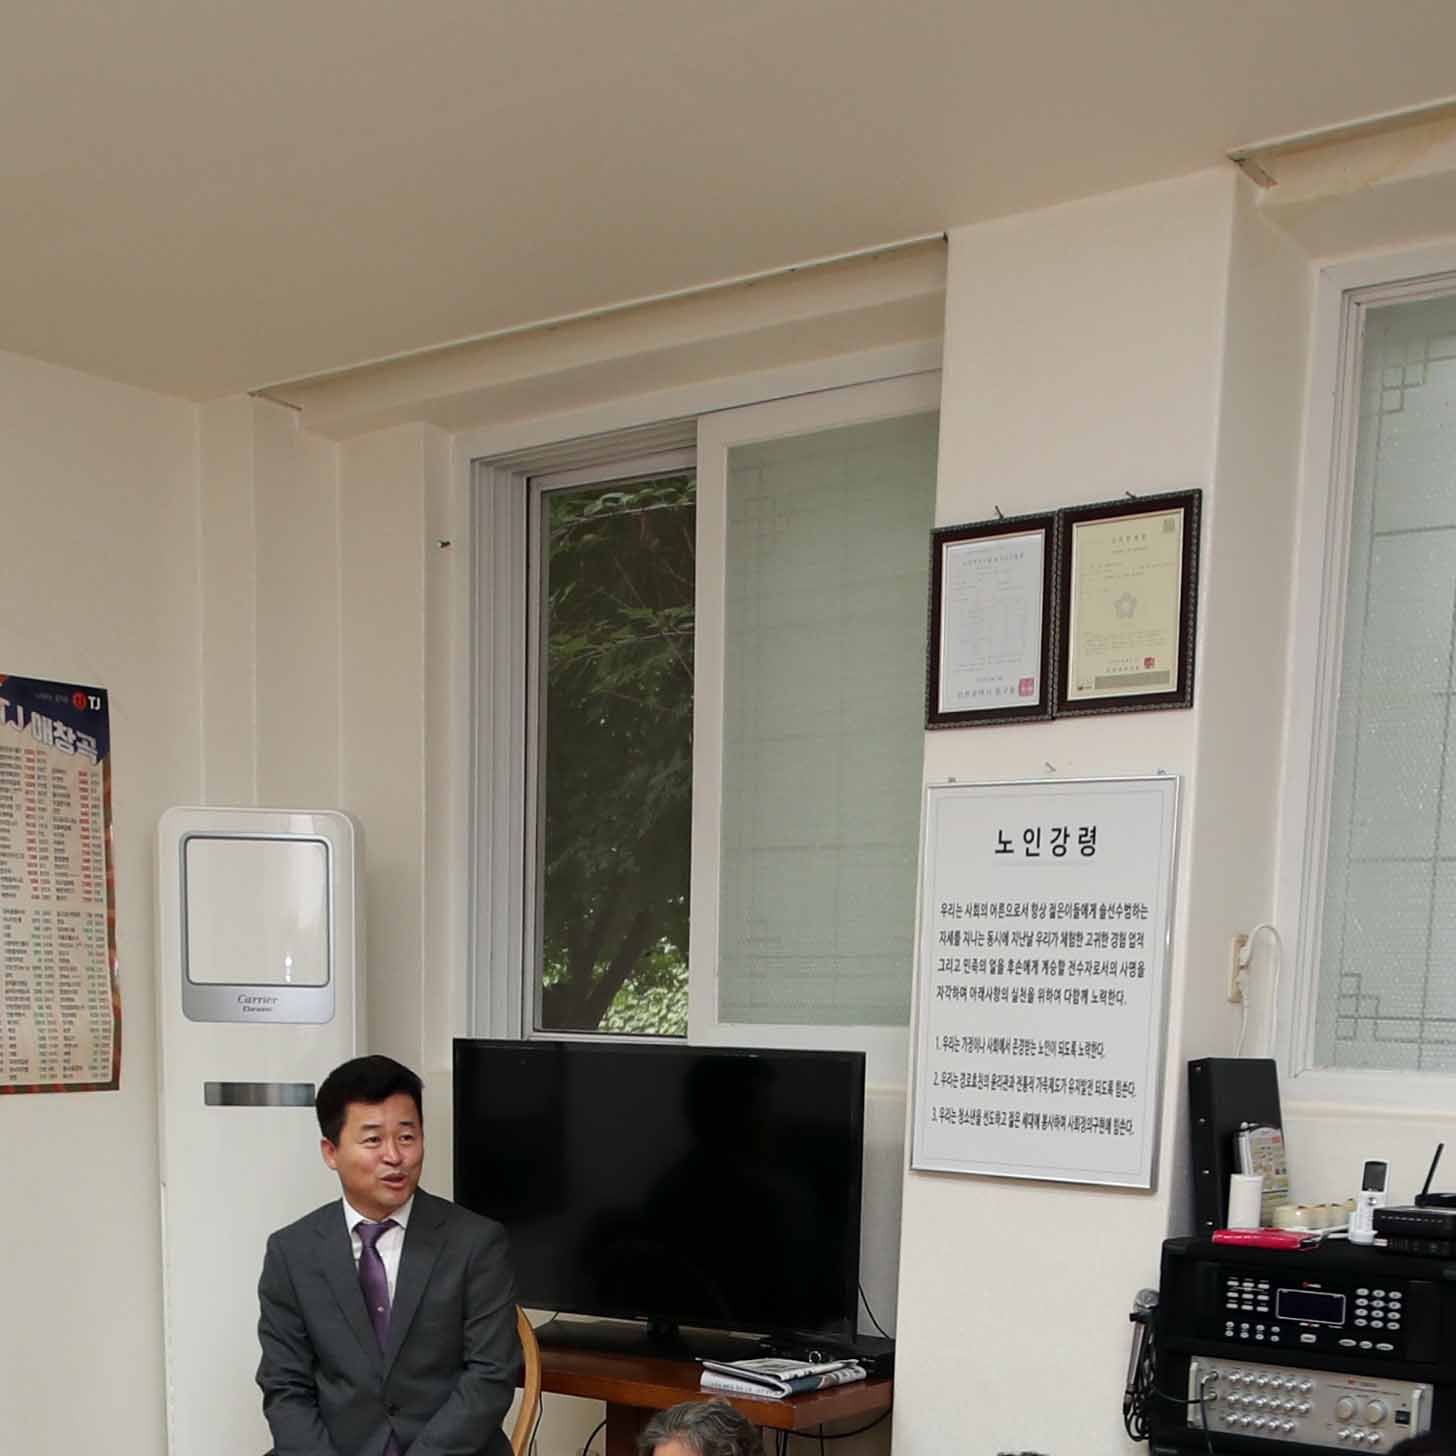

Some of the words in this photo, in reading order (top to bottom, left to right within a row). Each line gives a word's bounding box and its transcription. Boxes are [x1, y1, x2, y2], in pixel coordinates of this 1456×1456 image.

[87, 695, 101, 712] TJ
[31, 710, 99, 766] 애창곡
[940, 903, 963, 919] 우리는
[965, 903, 988, 919] 사회의
[990, 903, 1029, 919] 어른으로서
[1031, 902, 1047, 920] 항상
[1049, 902, 1096, 920] 젊은이들에게
[962, 930, 985, 947] 지니는
[1011, 930, 1034, 948] 지난날
[1035, 931, 1059, 948] 우리가
[1085, 931, 1109, 949] 고귀한
[1128, 931, 1144, 949] 업적
[937, 958, 961, 973] 그리고
[1006, 959, 1039, 976] 후손에게
[1041, 959, 1065, 977] 계승할
[1067, 960, 1117, 977] 전수자로서의
[1119, 961, 1145, 978] 사명을
[969, 986, 1008, 1002] 아래사항의
[1064, 988, 1089, 1005] 다함께
[1091, 988, 1126, 1006] 노력한다.
[943, 1036, 960, 1053] 우리는
[1058, 1041, 1076, 1058] 되도록
[941, 1071, 959, 1089] 우리는
[939, 1107, 957, 1124] 우리는
